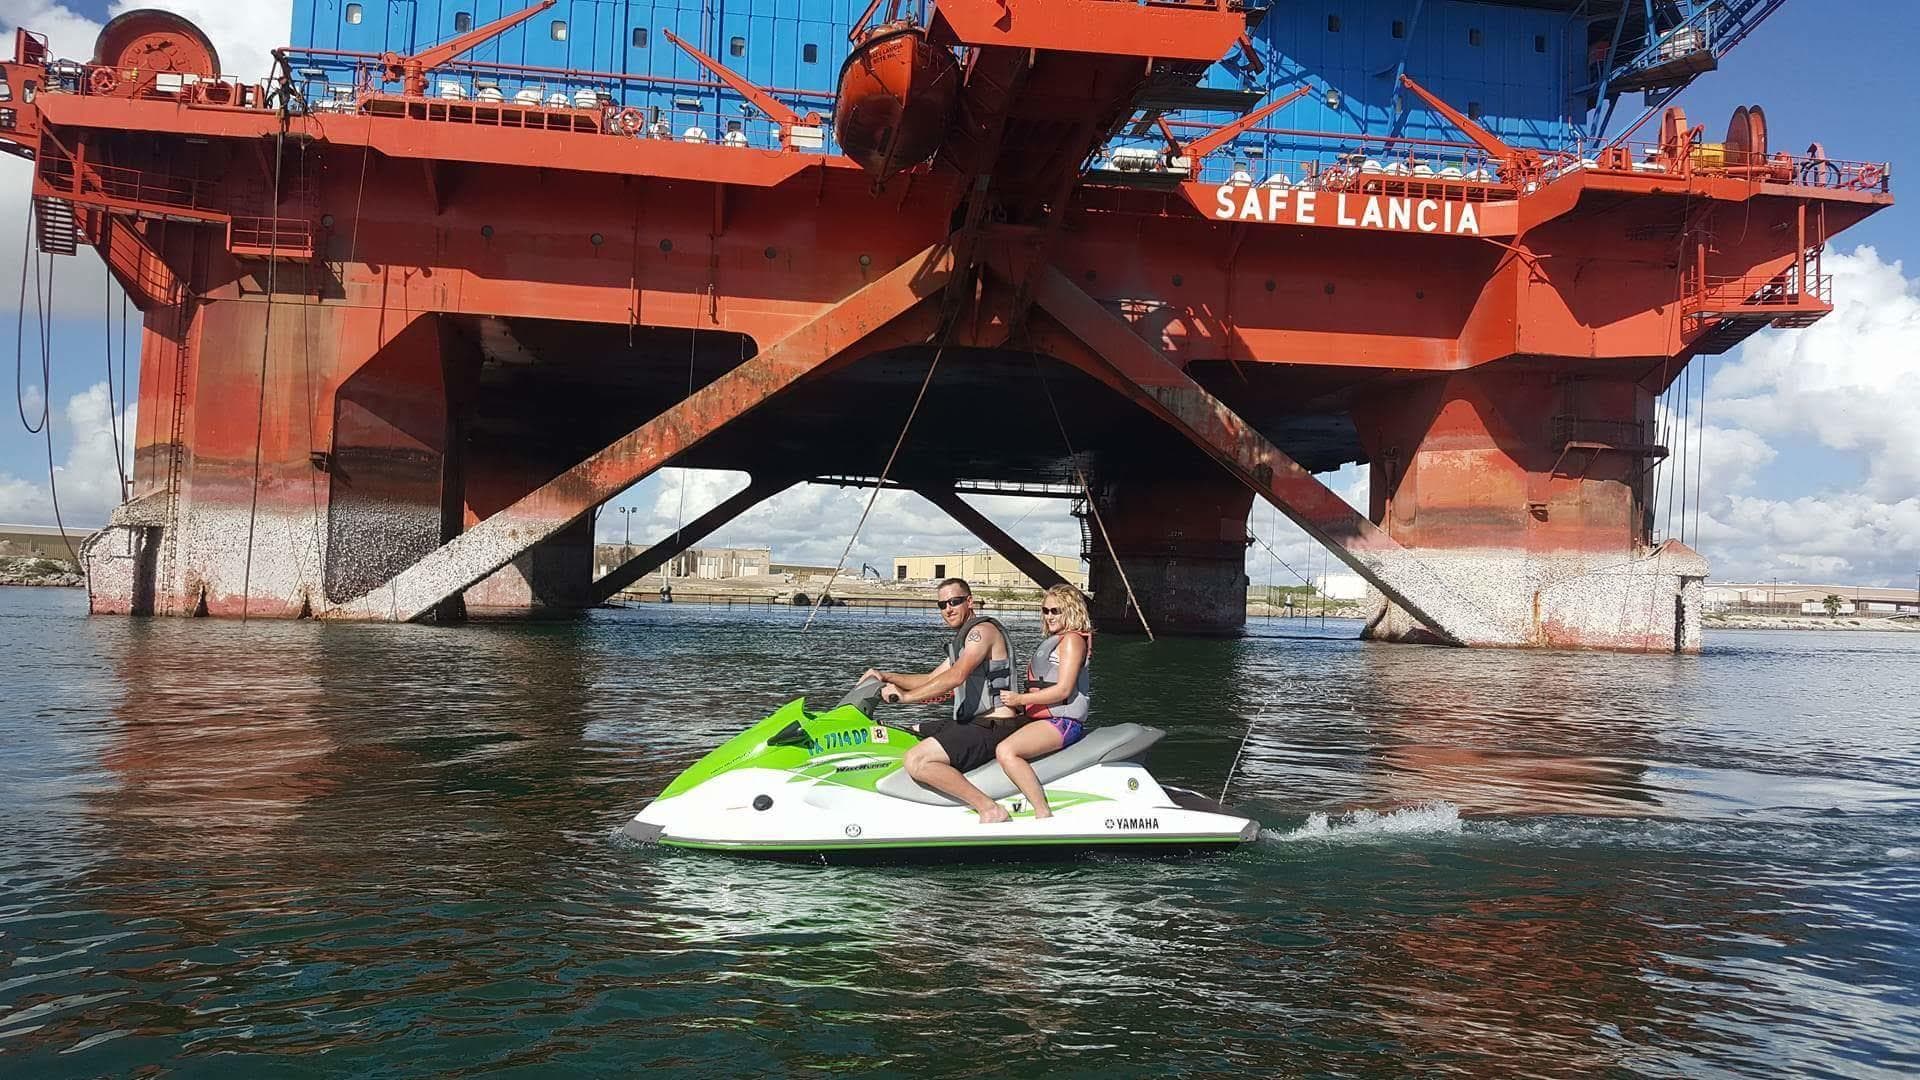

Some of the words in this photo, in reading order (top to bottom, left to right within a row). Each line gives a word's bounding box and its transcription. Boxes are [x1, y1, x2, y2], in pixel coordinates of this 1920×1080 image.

[1216, 186, 1316, 224] SAFE
[1337, 193, 1480, 234] LANCIA
[824, 731, 852, 750] 7714
[852, 728, 869, 746] DP
[1117, 818, 1159, 830] YAMAHA
